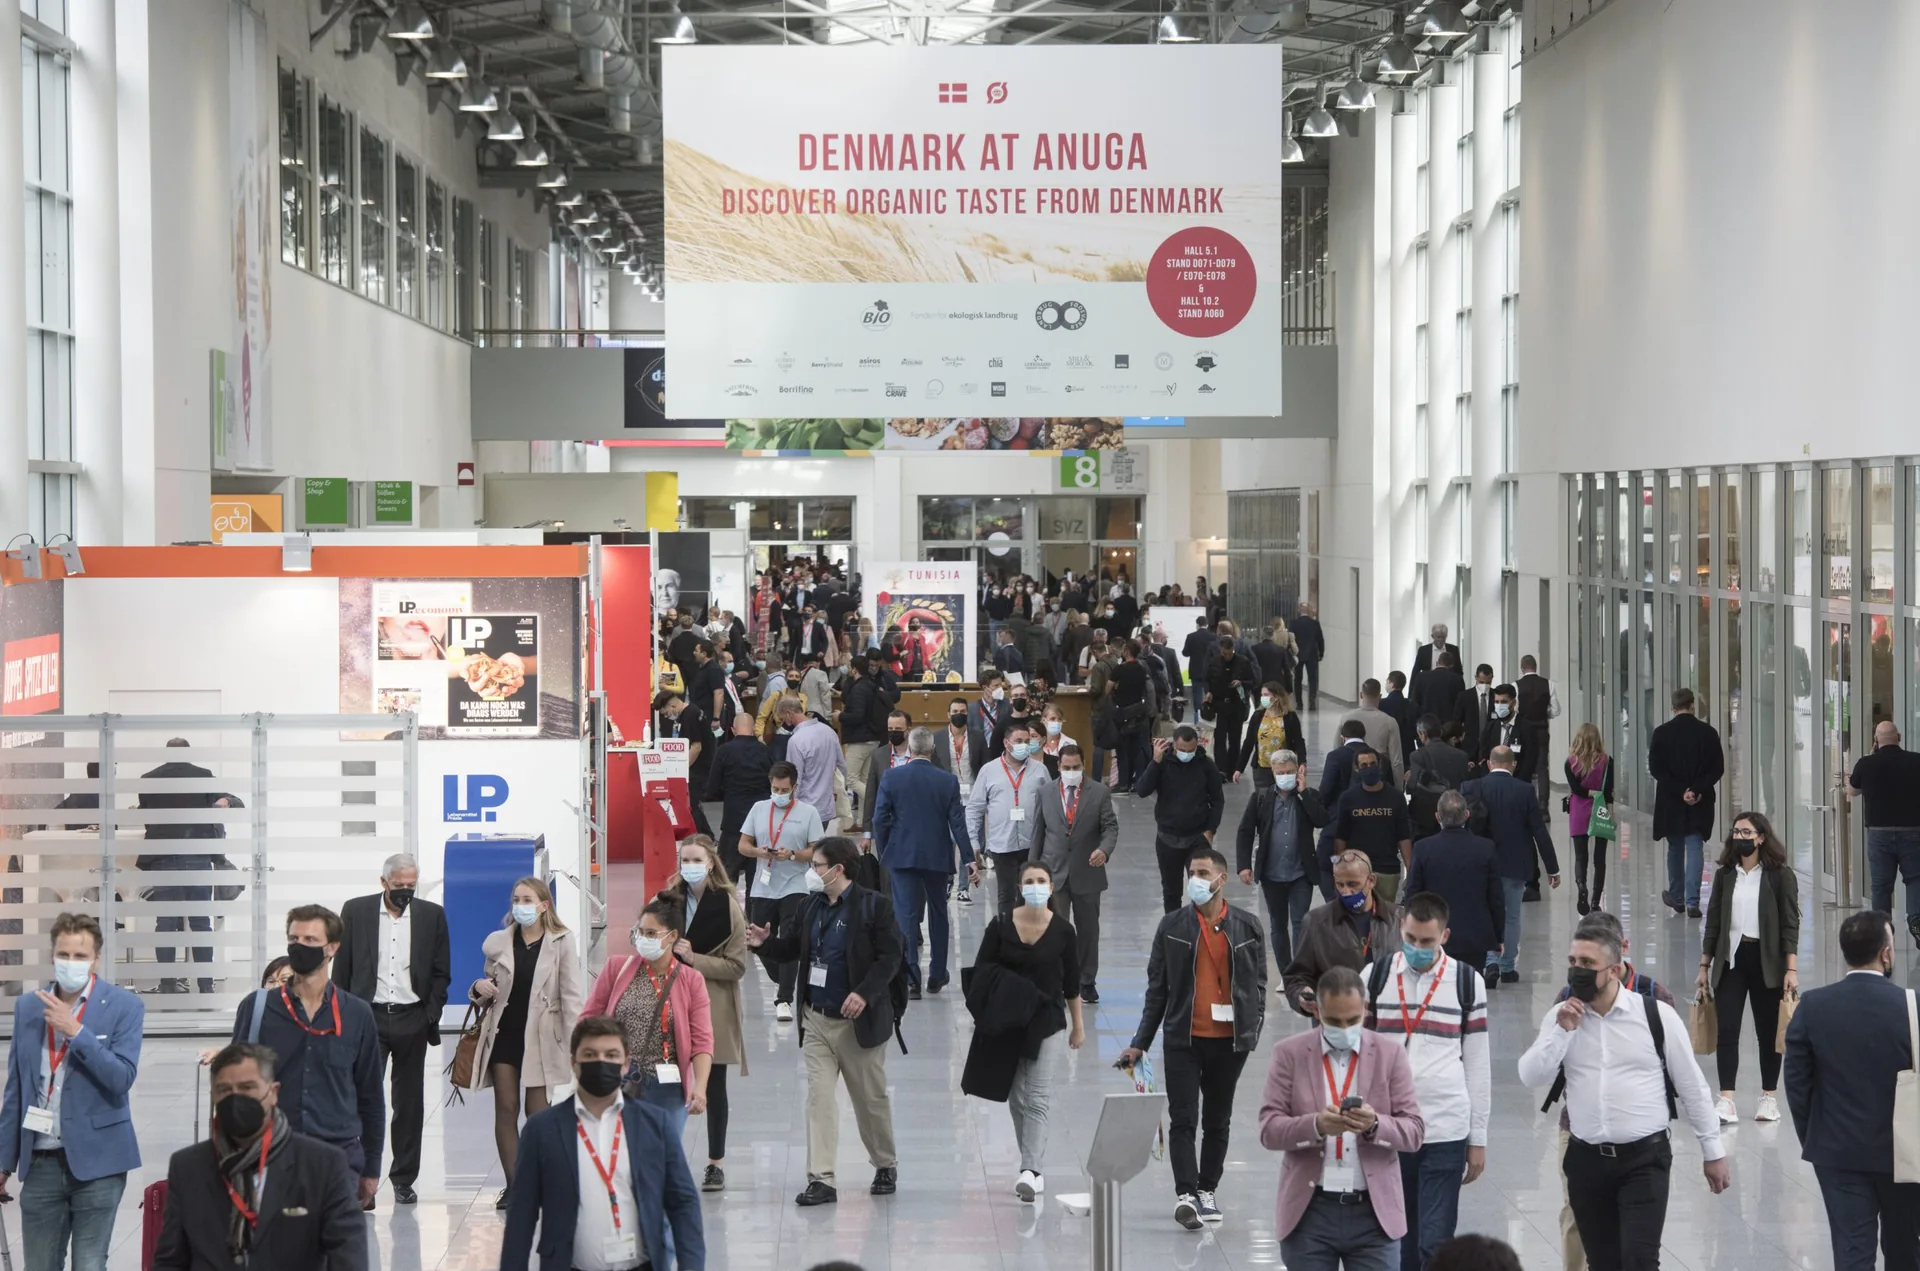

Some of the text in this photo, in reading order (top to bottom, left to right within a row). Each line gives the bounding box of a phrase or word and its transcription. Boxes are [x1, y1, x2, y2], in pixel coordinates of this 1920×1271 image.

[798, 132, 1147, 172] DENMARK AT ANUGA
[722, 187, 1224, 215] DISCOVER ORGANIC TASTE FROM DENMARK
[1184, 246, 1218, 256] HALL 5.1
[1166, 258, 1190, 268] STAND
[1184, 272, 1226, 280] E070-E078
[1198, 284, 1204, 292] &
[1180, 296, 1220, 306] HALL 10.2
[948, 312, 984, 320] økologisk
[984, 312, 1018, 320] landbrug
[1178, 309, 1224, 318] STAND A060
[1074, 456, 1098, 488] 8
[1054, 520, 1084, 534] SVZ
[908, 570, 960, 580] TUNISIA
[460, 701, 526, 710] DA KANN NOCH WAS
[644, 755, 660, 763] FOOD
[1352, 808, 1392, 816] CINEASTE
